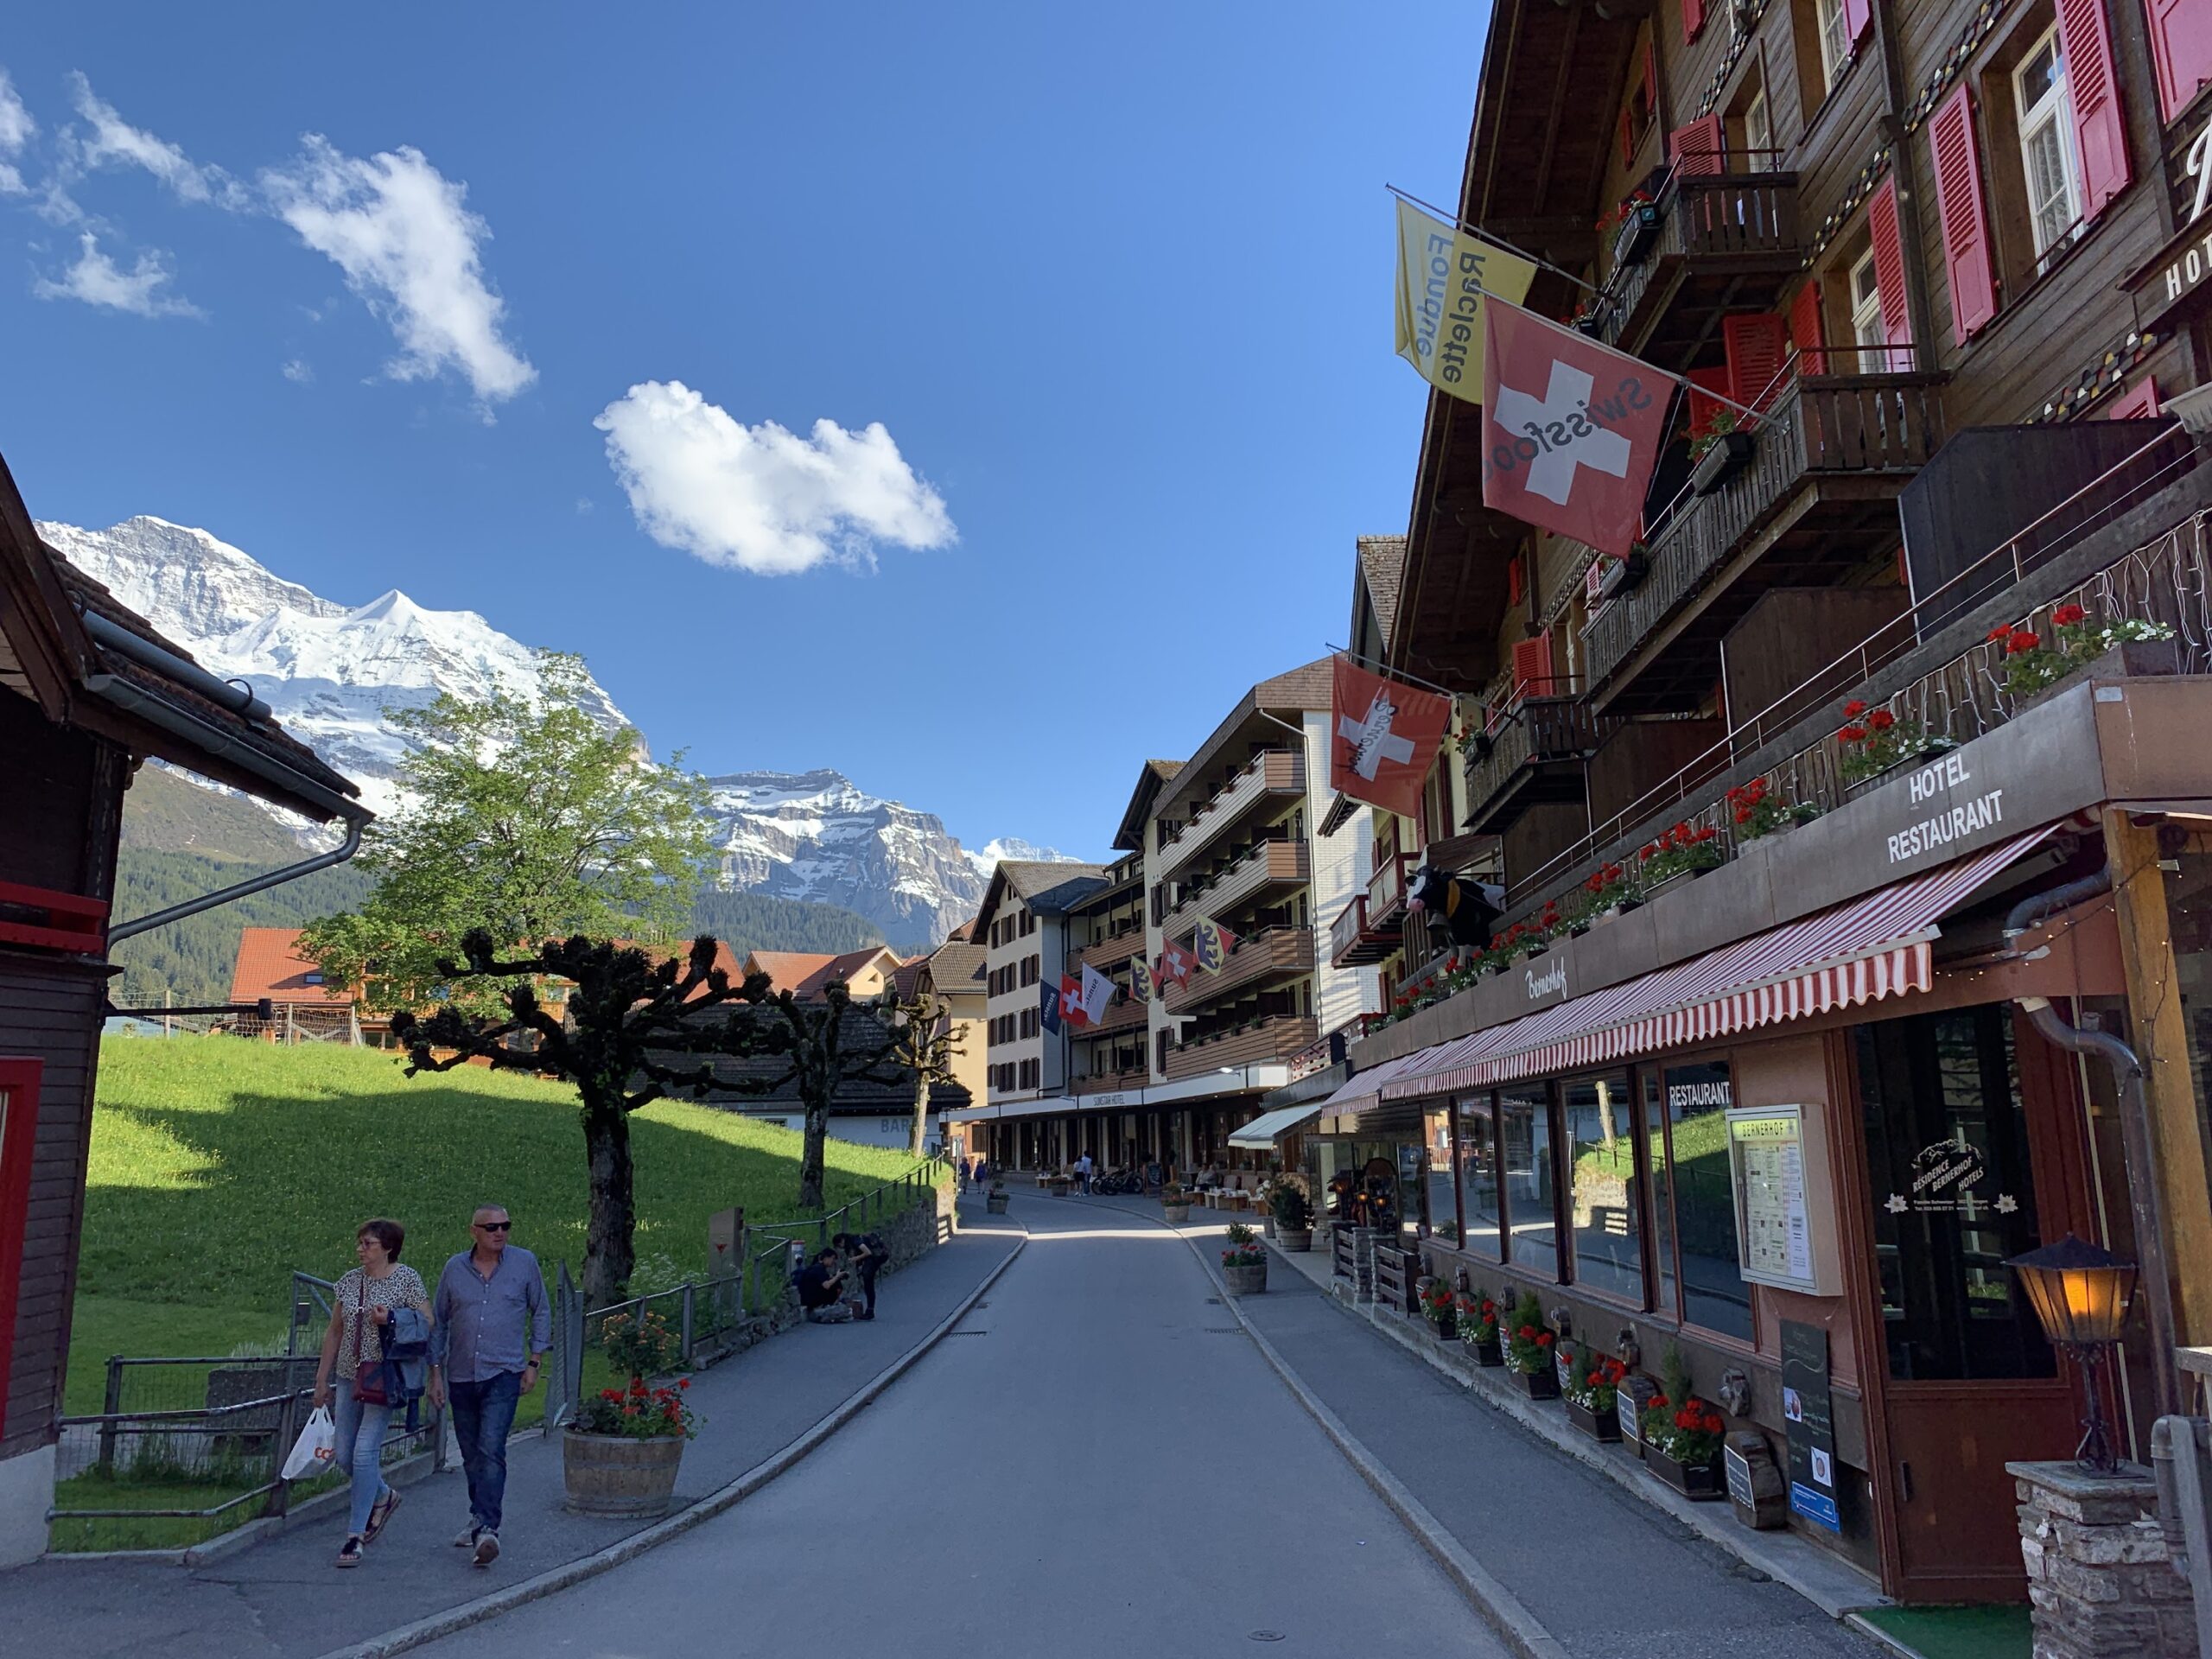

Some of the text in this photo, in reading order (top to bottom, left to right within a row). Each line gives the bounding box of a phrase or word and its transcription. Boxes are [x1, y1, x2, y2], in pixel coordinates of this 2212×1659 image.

[1910, 753, 1971, 804] HOTEL
[1887, 789, 2003, 864] RESTAURANT
[1524, 956, 1567, 1000] Bernerhof
[1112, 1094, 1125, 1105] HOTEL
[1669, 1081, 1730, 1107] RESTAURANT
[881, 1118, 910, 1133] BAR
[1742, 1122, 1783, 1137] BERNERHOF
[1932, 1156, 1973, 1192] BERNERHOF
[1958, 1166, 1984, 1192] HOTELS
